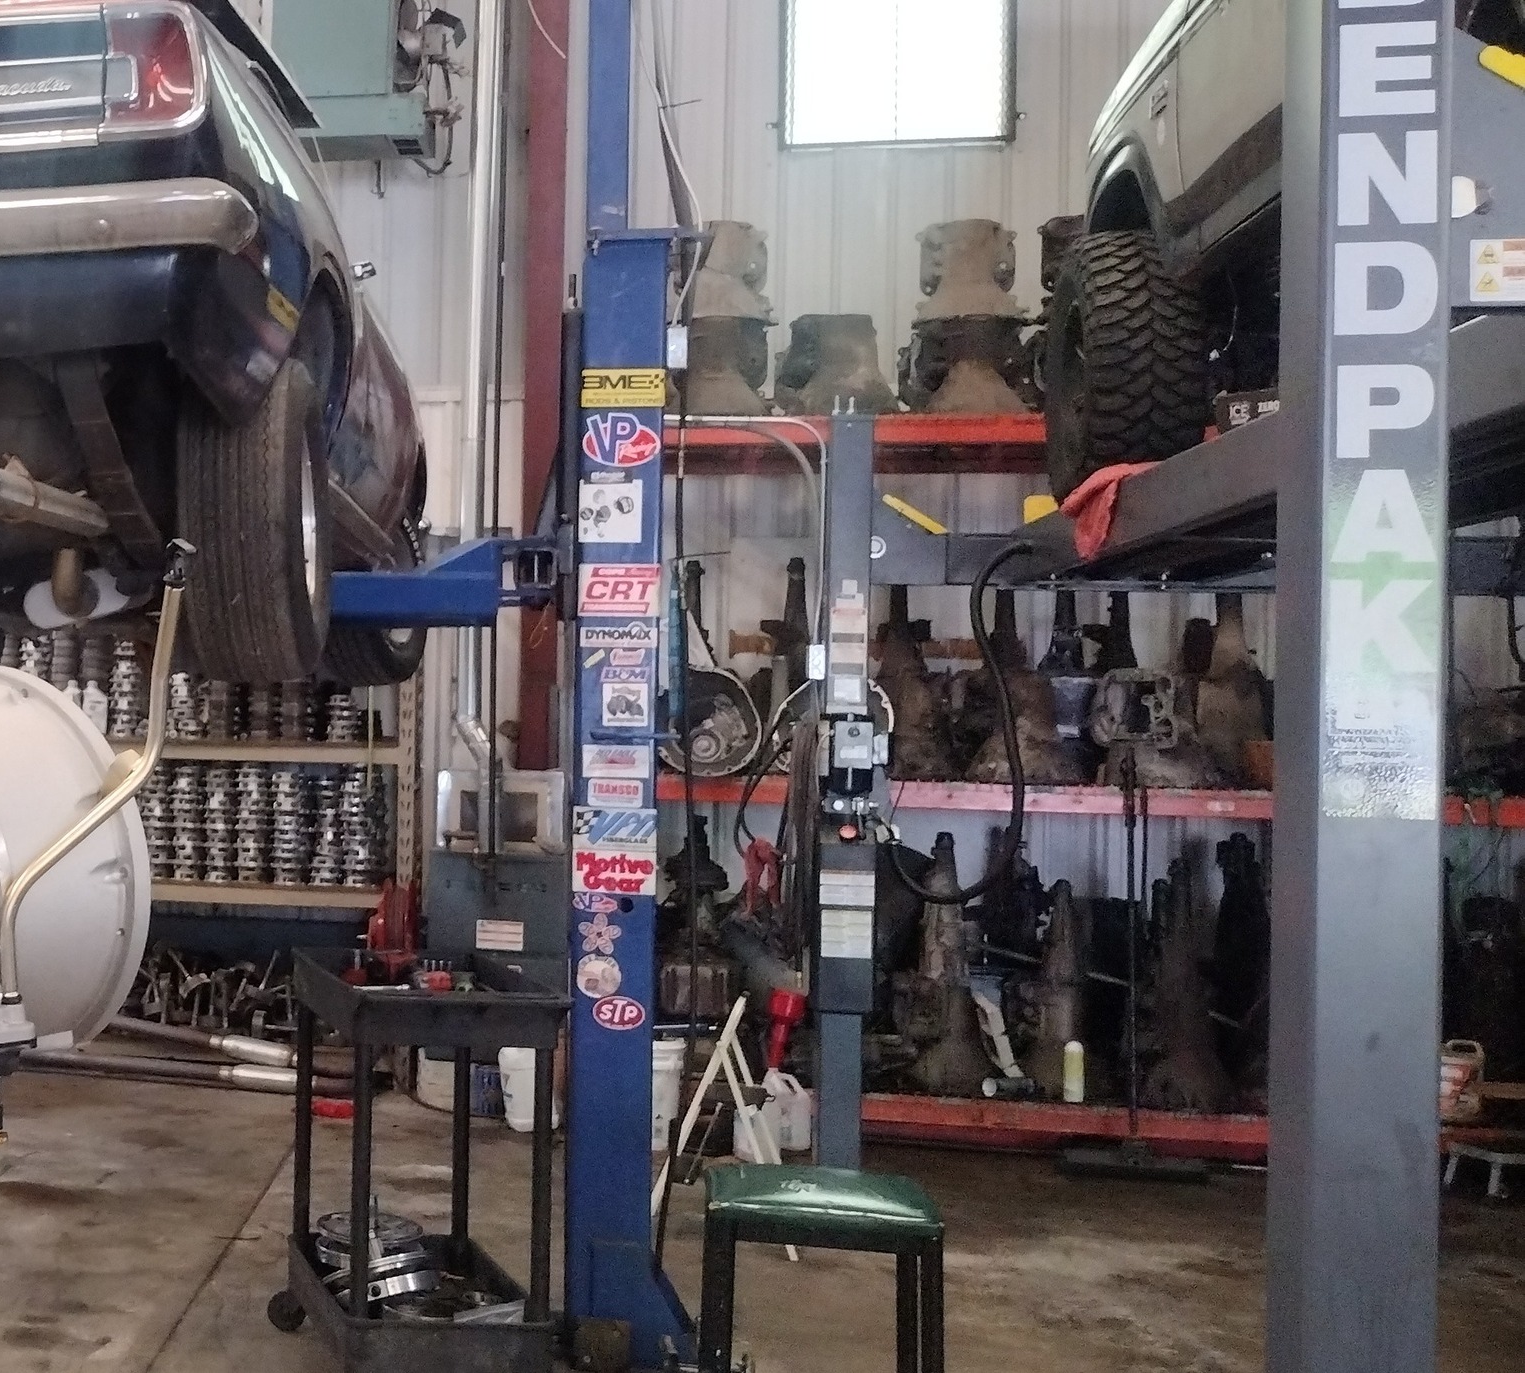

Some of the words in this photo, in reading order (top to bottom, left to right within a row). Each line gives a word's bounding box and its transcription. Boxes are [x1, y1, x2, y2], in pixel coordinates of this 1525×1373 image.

[1329, 0, 1440, 673] ENDPAK
[586, 412, 640, 465] VP
[585, 581, 656, 600] CRT
[576, 852, 654, 875] Motive
[583, 871, 646, 893] Gear
[599, 999, 639, 1024] STP
